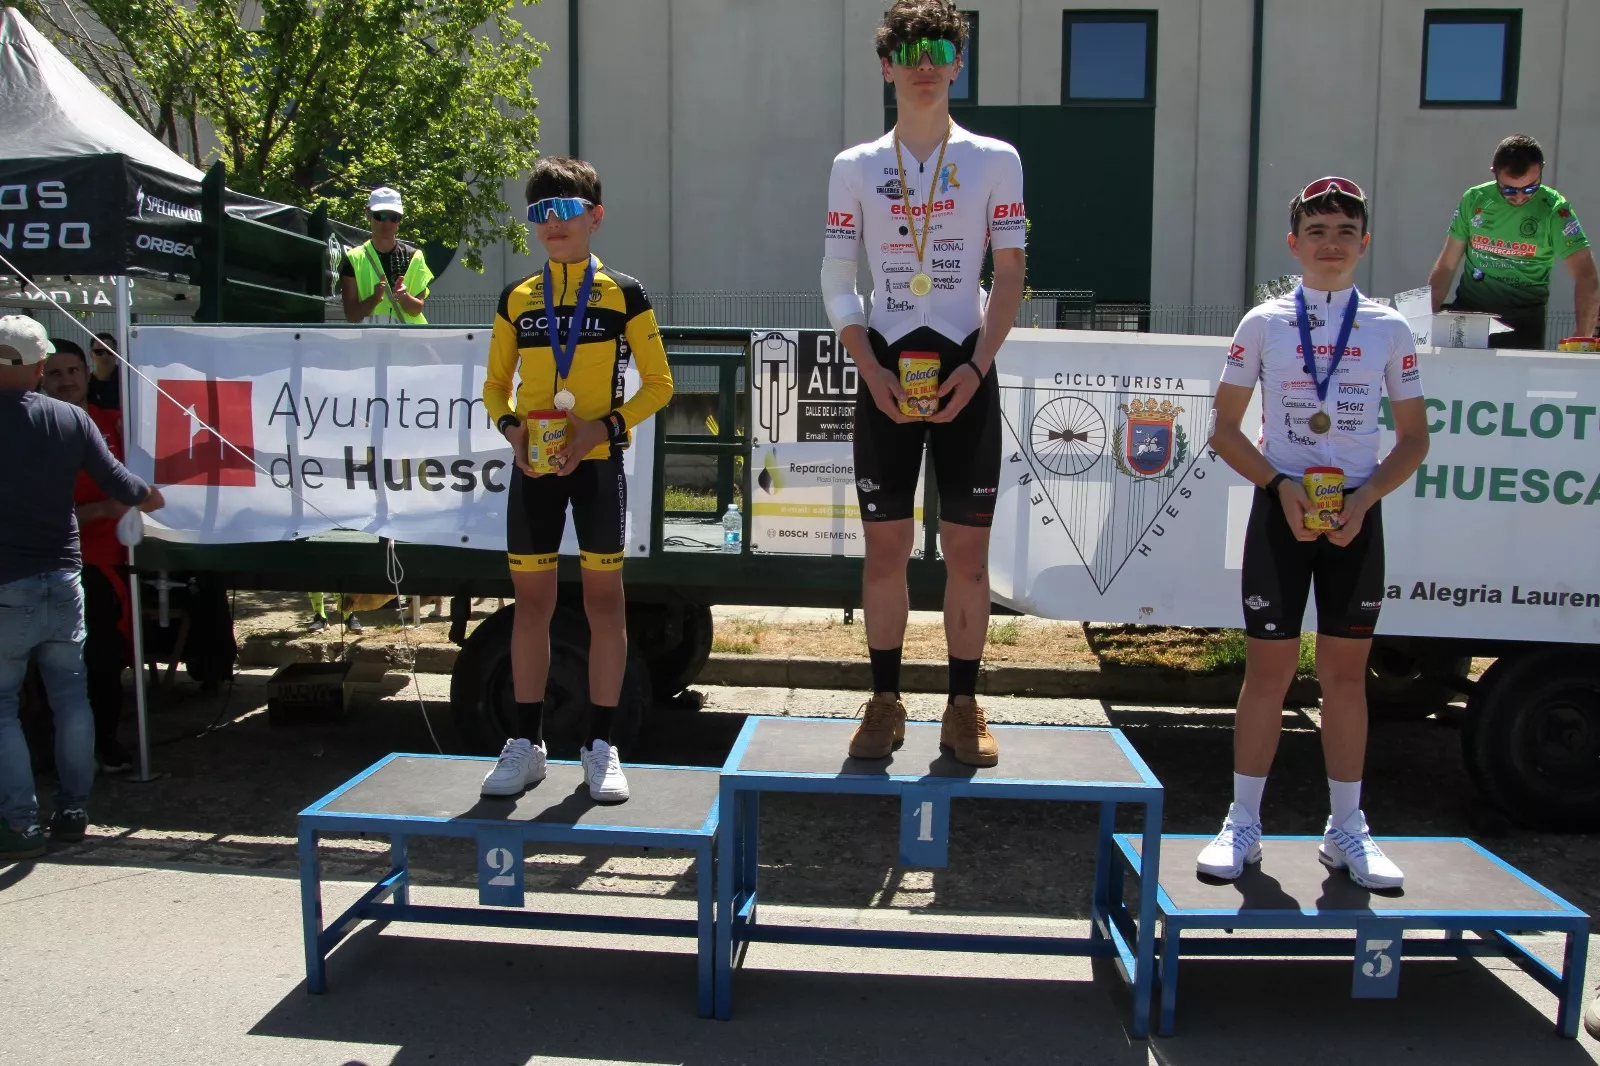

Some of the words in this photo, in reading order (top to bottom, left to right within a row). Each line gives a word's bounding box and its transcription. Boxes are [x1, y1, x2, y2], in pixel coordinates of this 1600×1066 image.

[883, 167, 907, 176] GOBK
[146, 195, 202, 223] SPECIALIZED
[993, 202, 1025, 218] BM
[136, 234, 196, 259] ORBEA
[807, 366, 858, 394] ALO
[1054, 372, 1185, 390] CICLOTURISTA
[1338, 386, 1369, 396] MONAJ
[805, 406, 821, 416] CALLE
[822, 406, 830, 417] DE
[830, 407, 837, 417] LA
[1424, 398, 1600, 440] CICLOT
[805, 432, 828, 440] Email:
[270, 445, 324, 489] de
[344, 446, 506, 493] Huesc
[789, 462, 855, 475] Reparacione
[778, 530, 808, 538] BOSCH
[815, 531, 857, 540] SIEMENS
[1410, 581, 1502, 606] Alegria
[1511, 585, 1600, 608] Lauren
[913, 801, 934, 841] 1
[486, 847, 516, 886] 2
[1362, 939, 1393, 978] 3
